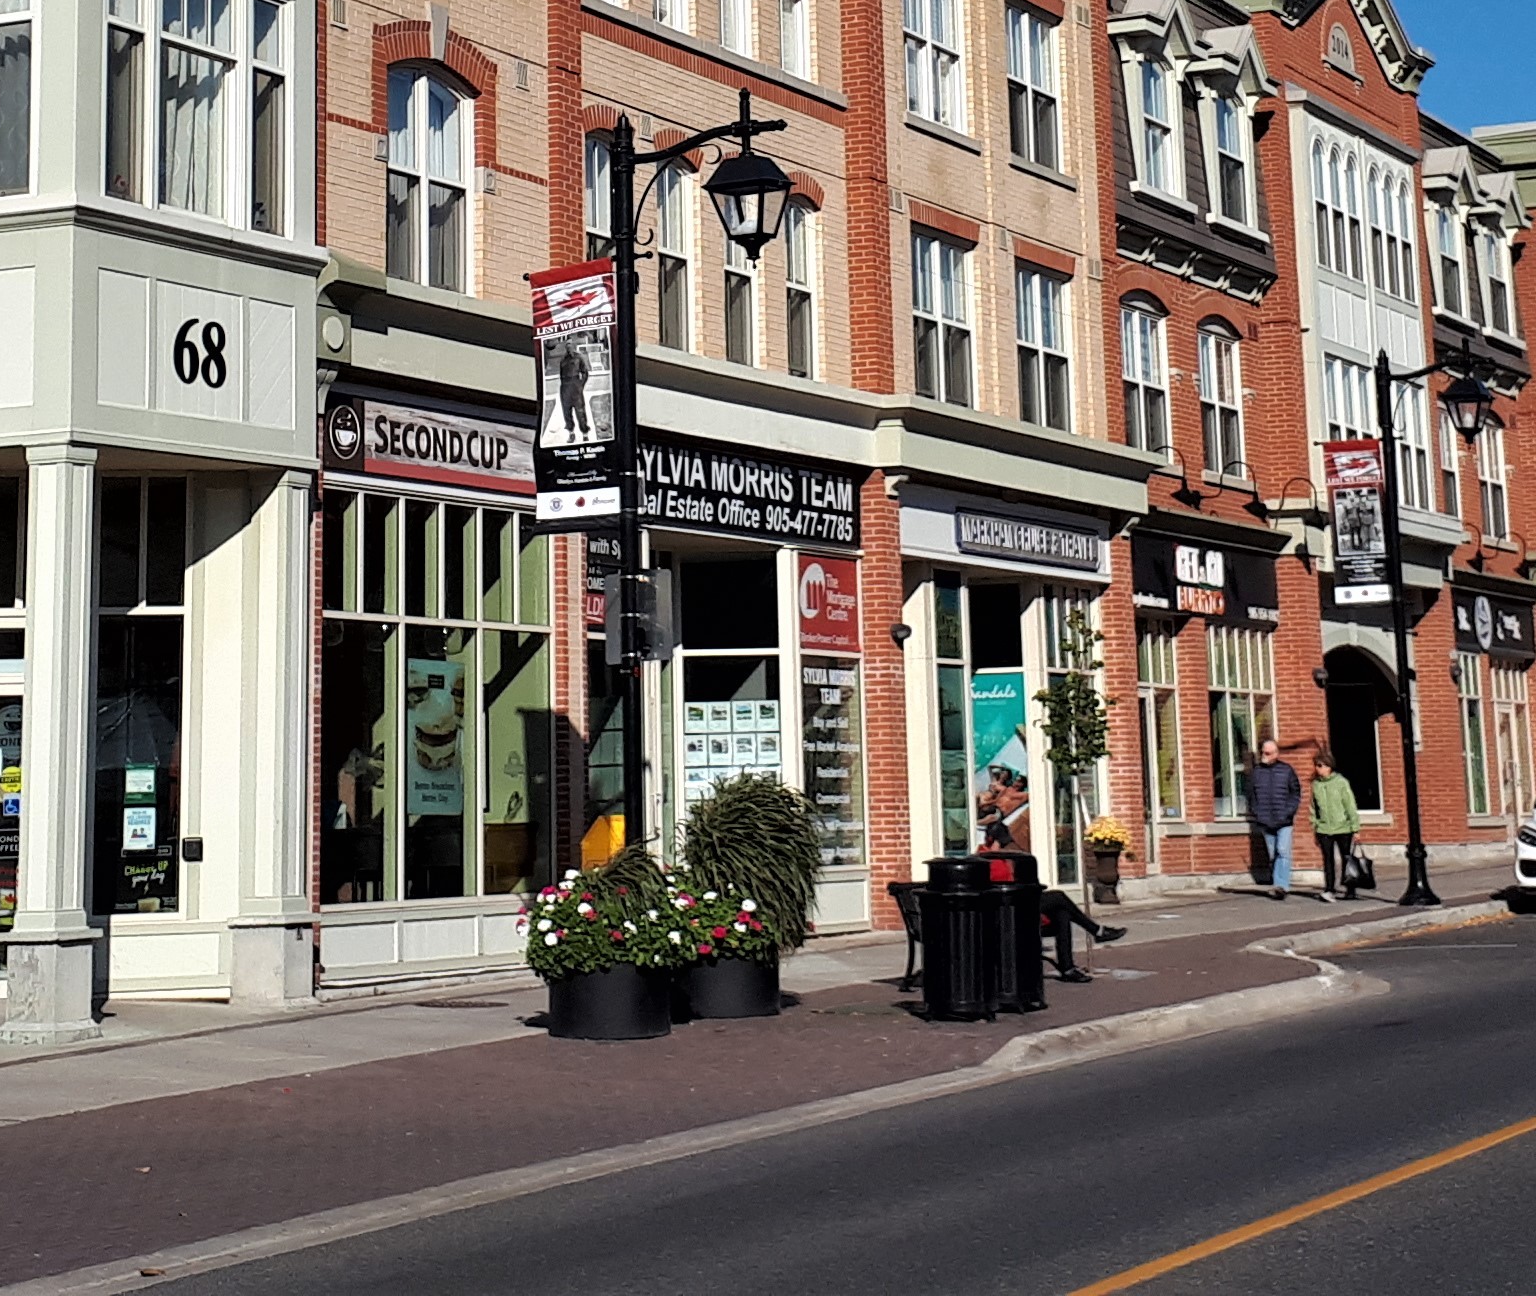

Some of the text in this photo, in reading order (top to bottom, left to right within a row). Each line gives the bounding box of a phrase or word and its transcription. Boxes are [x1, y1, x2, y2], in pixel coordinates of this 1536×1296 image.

[536, 313, 613, 336] LEST WE FORGET
[173, 318, 227, 389] 68
[374, 415, 509, 471] SECOND CUP
[711, 454, 794, 503] MORRIS
[797, 469, 853, 512] TEAM
[665, 490, 714, 522] Estate
[717, 497, 761, 529] Office
[765, 505, 853, 542] 905-477-7785
[589, 537, 610, 555] with
[1176, 585, 1225, 615] BURRITO
